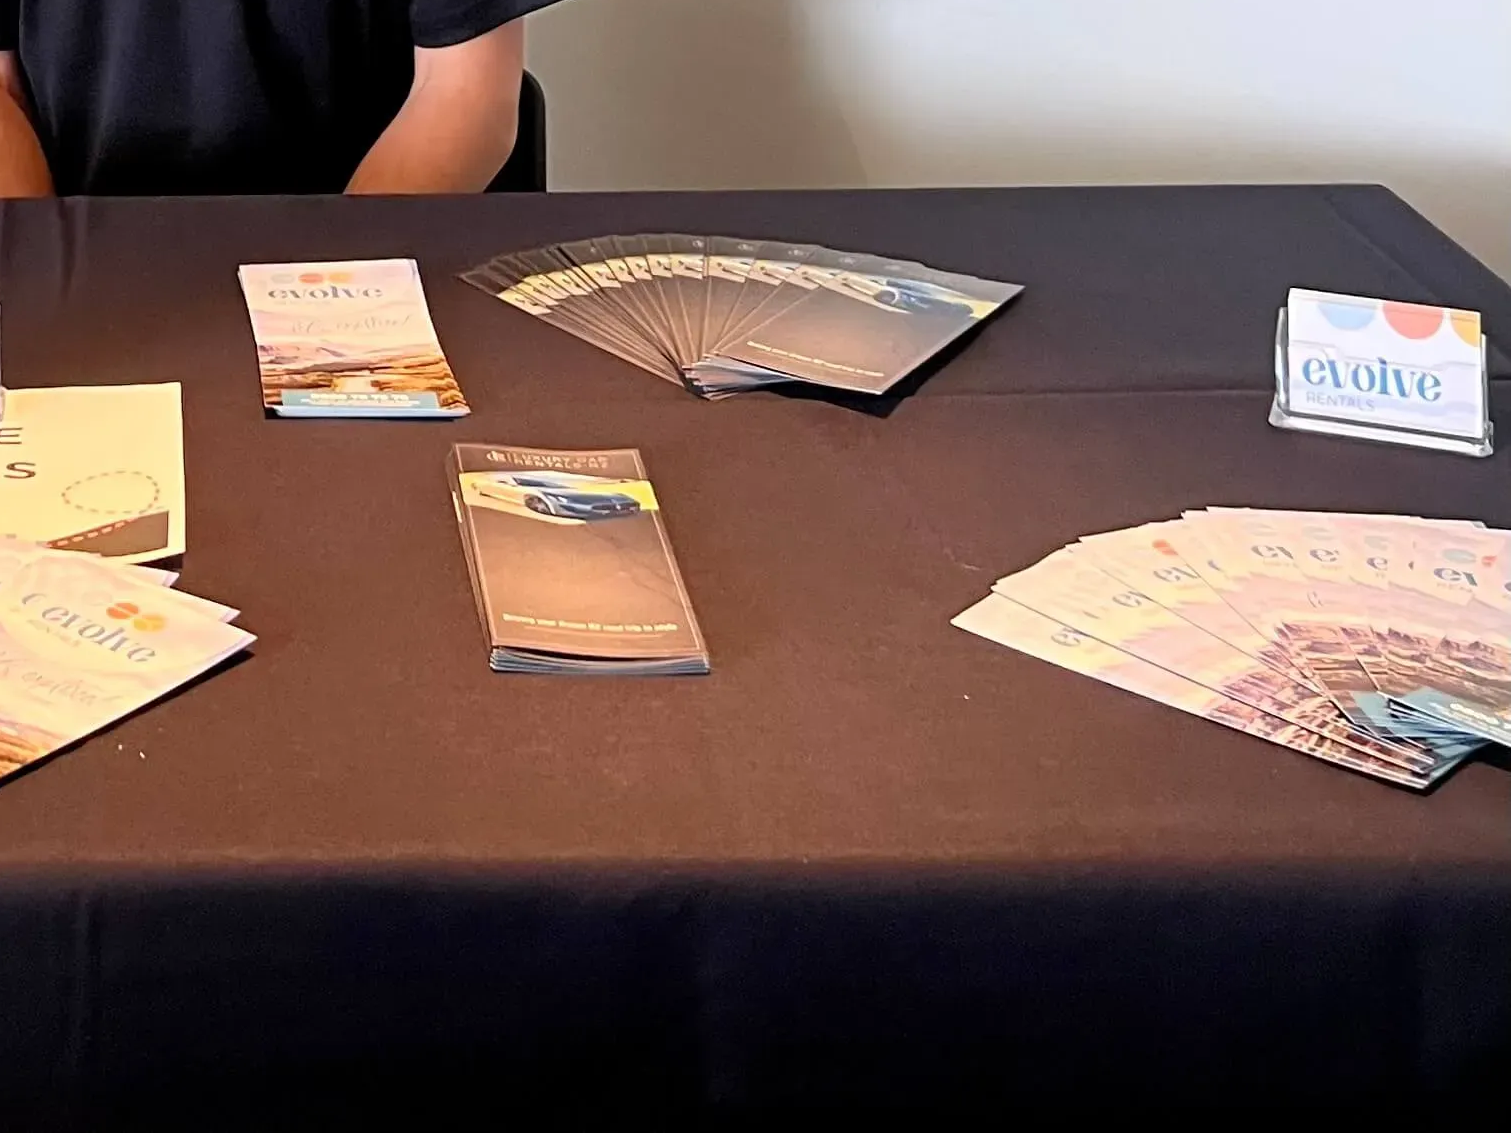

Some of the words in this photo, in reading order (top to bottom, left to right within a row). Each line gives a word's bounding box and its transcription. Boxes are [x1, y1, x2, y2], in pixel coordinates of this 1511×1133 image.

[267, 285, 384, 300] evolve
[1301, 356, 1443, 403] evolve
[1305, 390, 1376, 413] RENTALS
[40, 605, 159, 664] evolve
